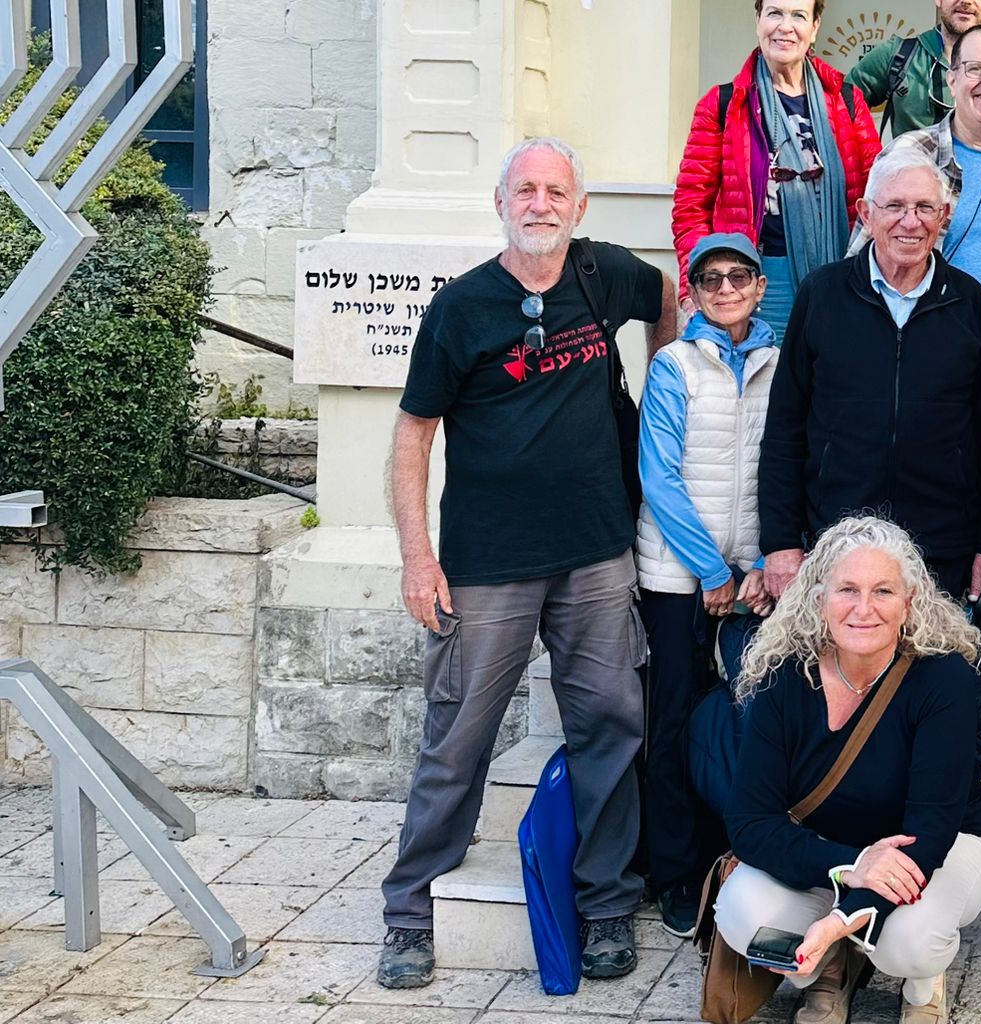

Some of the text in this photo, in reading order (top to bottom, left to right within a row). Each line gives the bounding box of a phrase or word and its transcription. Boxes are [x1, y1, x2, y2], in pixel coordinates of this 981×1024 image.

[305, 268, 358, 290] שלום
[368, 272, 420, 294] משכן
[331, 300, 395, 316] שיטרית
[371, 342, 409, 357] (1945
